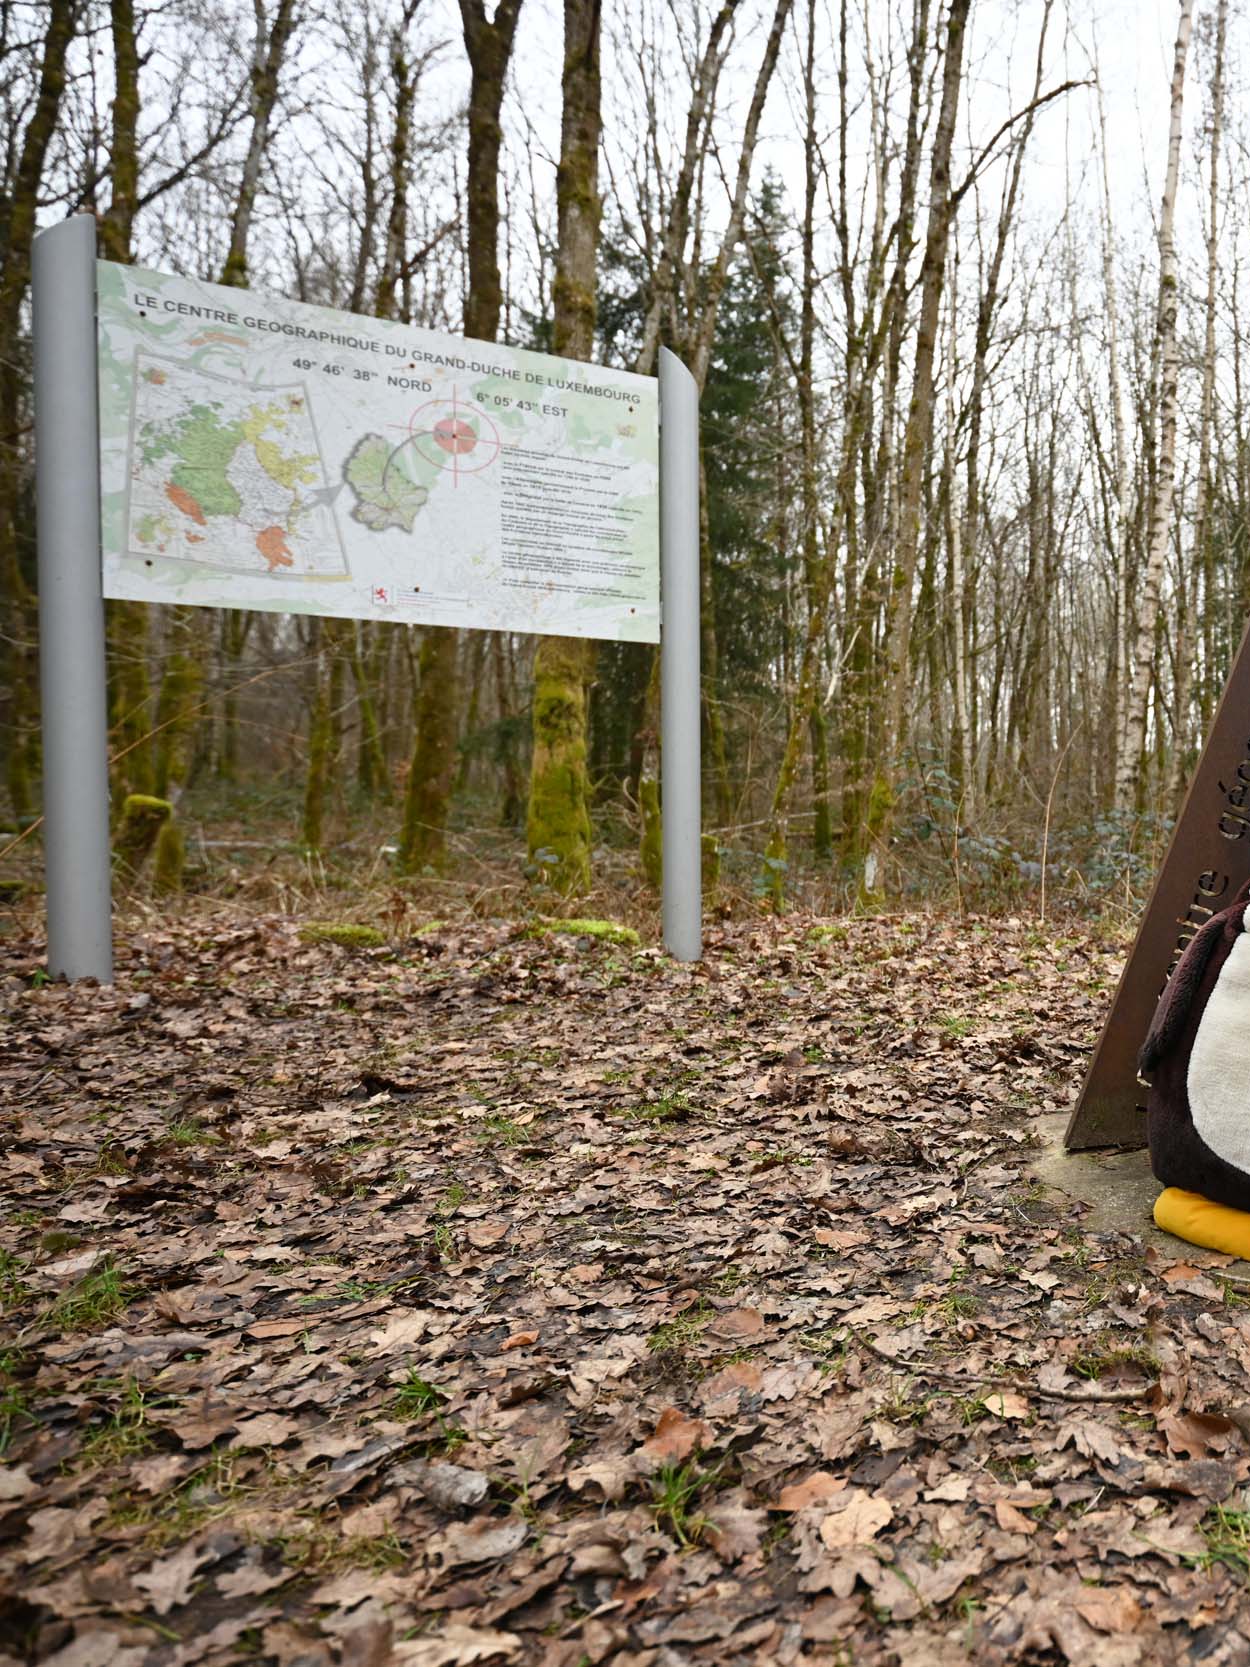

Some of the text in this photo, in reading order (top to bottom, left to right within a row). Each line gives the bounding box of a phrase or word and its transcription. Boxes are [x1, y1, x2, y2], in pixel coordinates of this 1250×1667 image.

[134, 294, 641, 404] LE CENTRE GEOGRAPHIQUE DU GRAND-DUCHE DE LUXEMBOURG
[387, 375, 432, 393] NORD
[542, 405, 569, 417] EST
